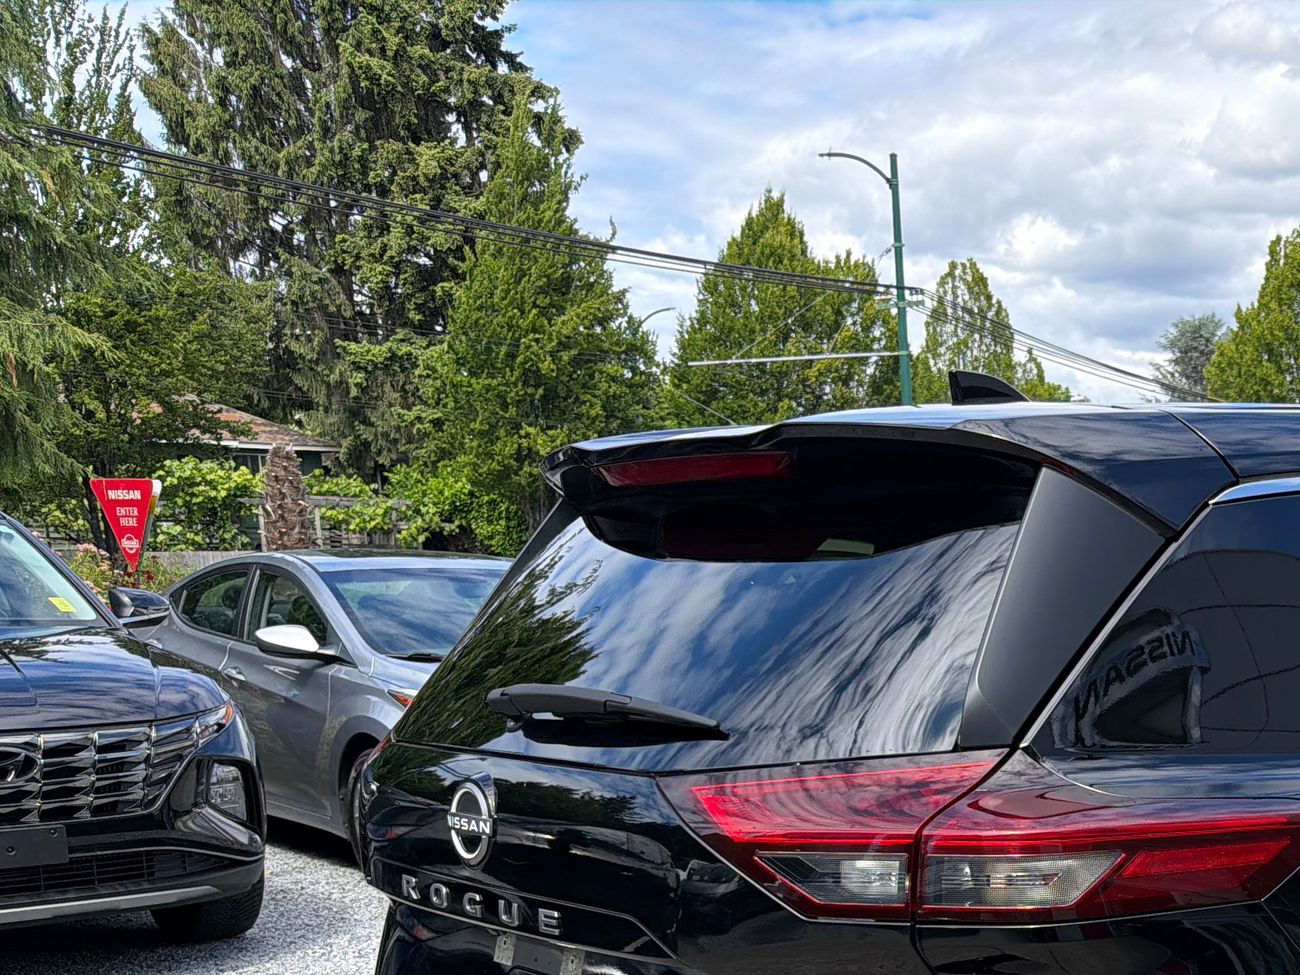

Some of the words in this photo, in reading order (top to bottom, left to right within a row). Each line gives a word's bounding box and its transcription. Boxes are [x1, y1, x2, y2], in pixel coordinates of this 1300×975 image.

[107, 489, 141, 500] NISSAN
[116, 506, 138, 516] ENTER
[120, 517, 138, 527] HERE
[447, 813, 491, 834] NISSAN
[402, 873, 563, 937] ROGUE
